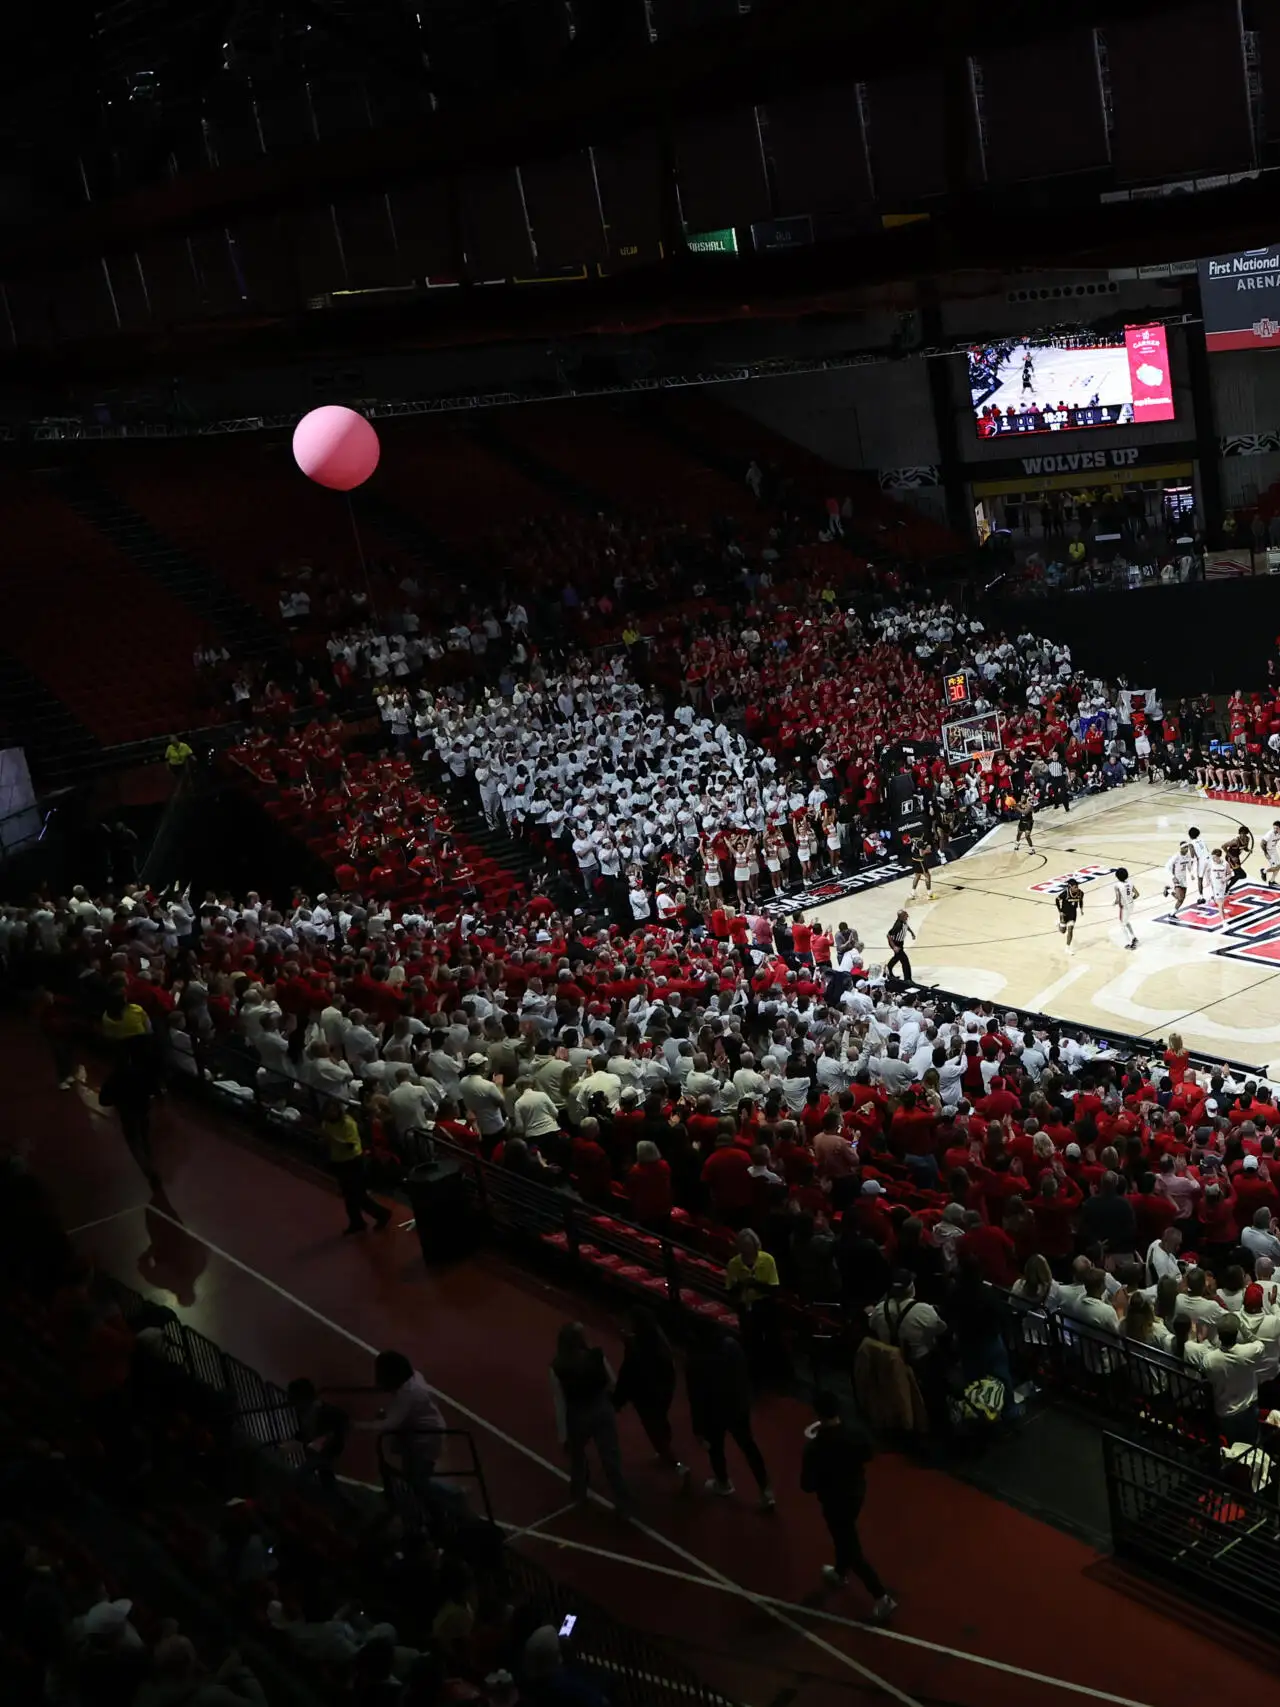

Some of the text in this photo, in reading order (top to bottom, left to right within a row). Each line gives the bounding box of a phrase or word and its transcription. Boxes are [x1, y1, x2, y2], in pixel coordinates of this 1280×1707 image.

[688, 240, 726, 252] ARSHALL
[1209, 260, 1231, 276] First
[1233, 254, 1279, 273] National
[1022, 451, 1107, 475] WOLVES
[1111, 448, 1139, 466] UP
[949, 684, 965, 701] 30
[838, 863, 913, 888] STATE
